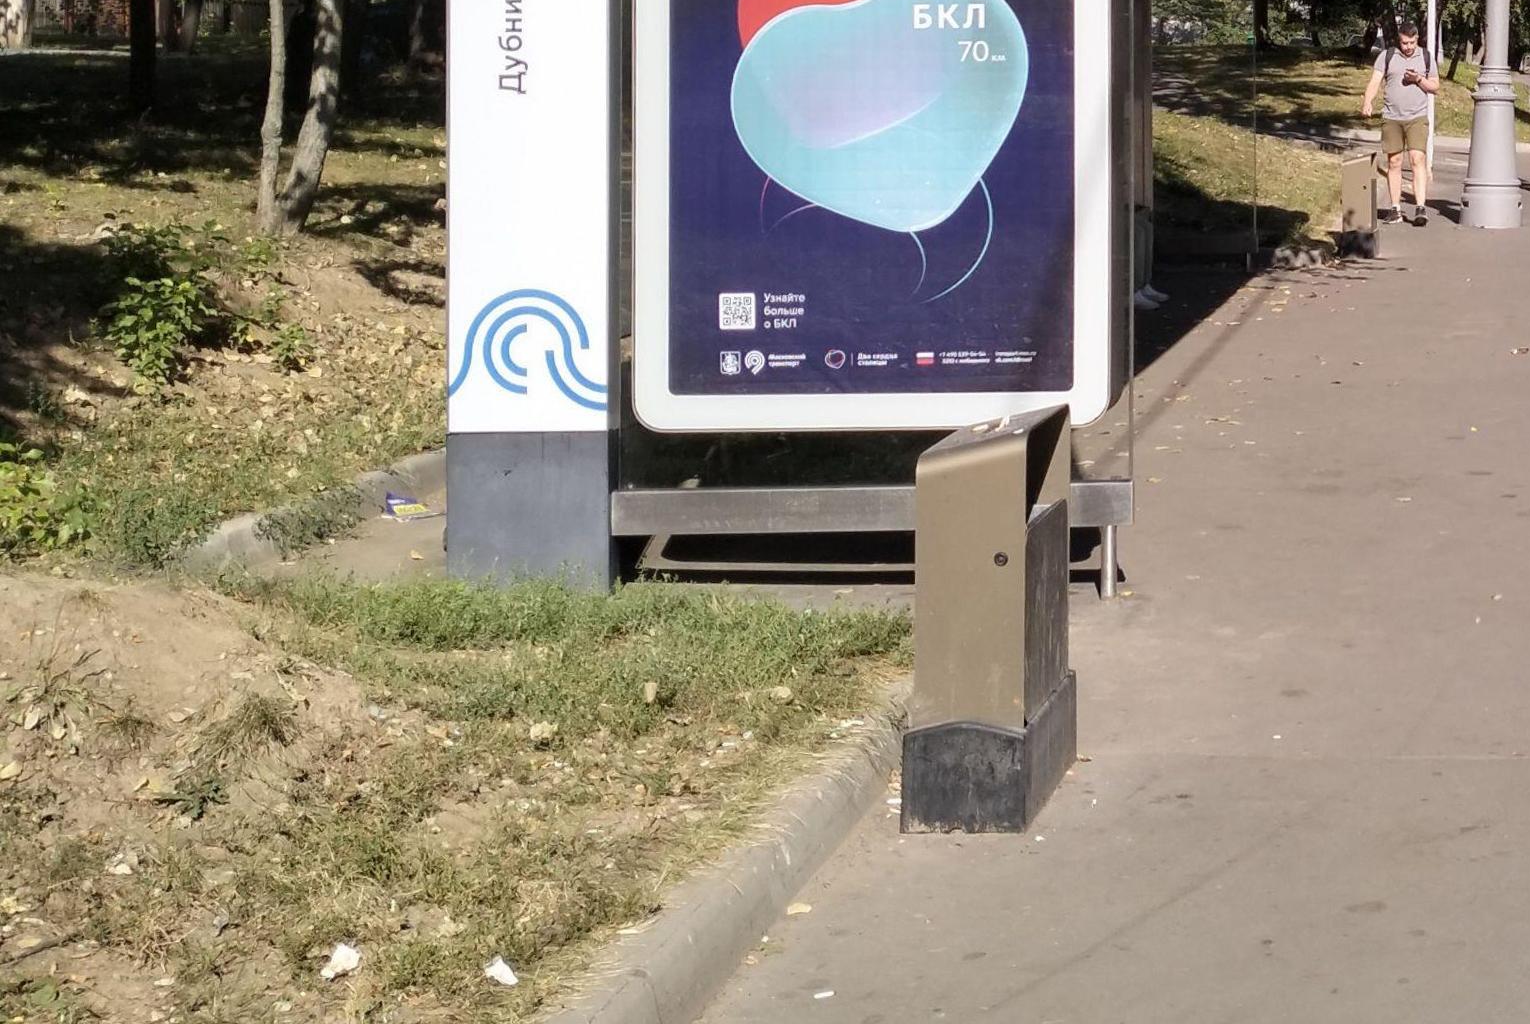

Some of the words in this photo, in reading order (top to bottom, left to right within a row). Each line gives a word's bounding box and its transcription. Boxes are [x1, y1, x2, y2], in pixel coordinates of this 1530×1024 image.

[912, 2, 986, 29] БКЛ
[957, 40, 990, 62] 70
[763, 305, 805, 316] больше
[763, 320, 772, 329] о
[773, 318, 798, 329] БКЛ
